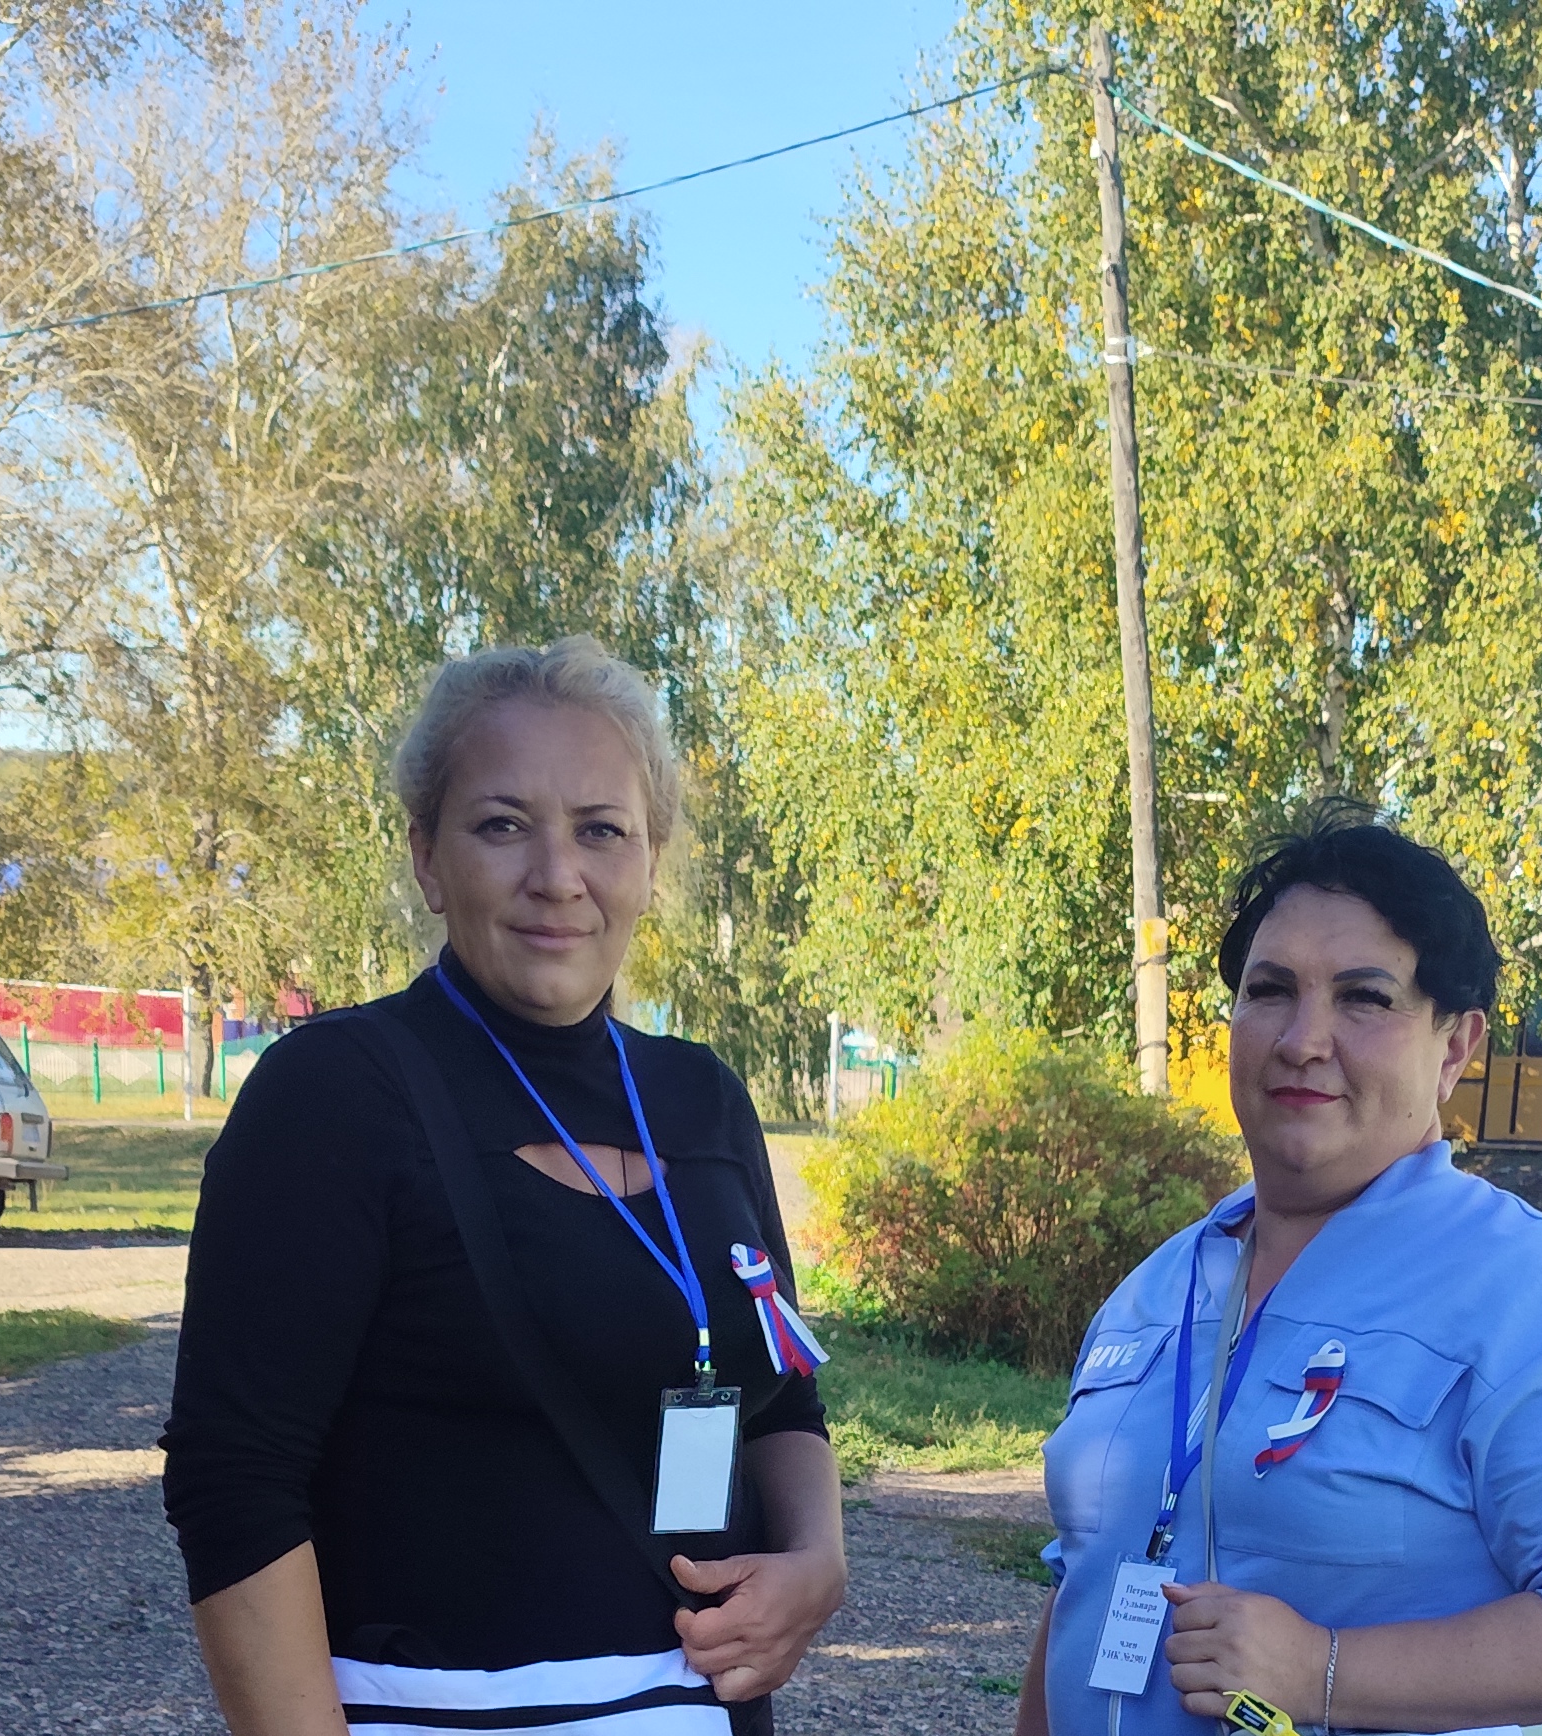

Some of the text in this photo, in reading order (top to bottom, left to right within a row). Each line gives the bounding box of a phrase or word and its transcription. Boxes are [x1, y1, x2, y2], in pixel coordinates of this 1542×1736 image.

[1126, 1584, 1159, 1598] Петрова
[1120, 1597, 1158, 1613] Гульнара
[1101, 1648, 1120, 1660] УИК
